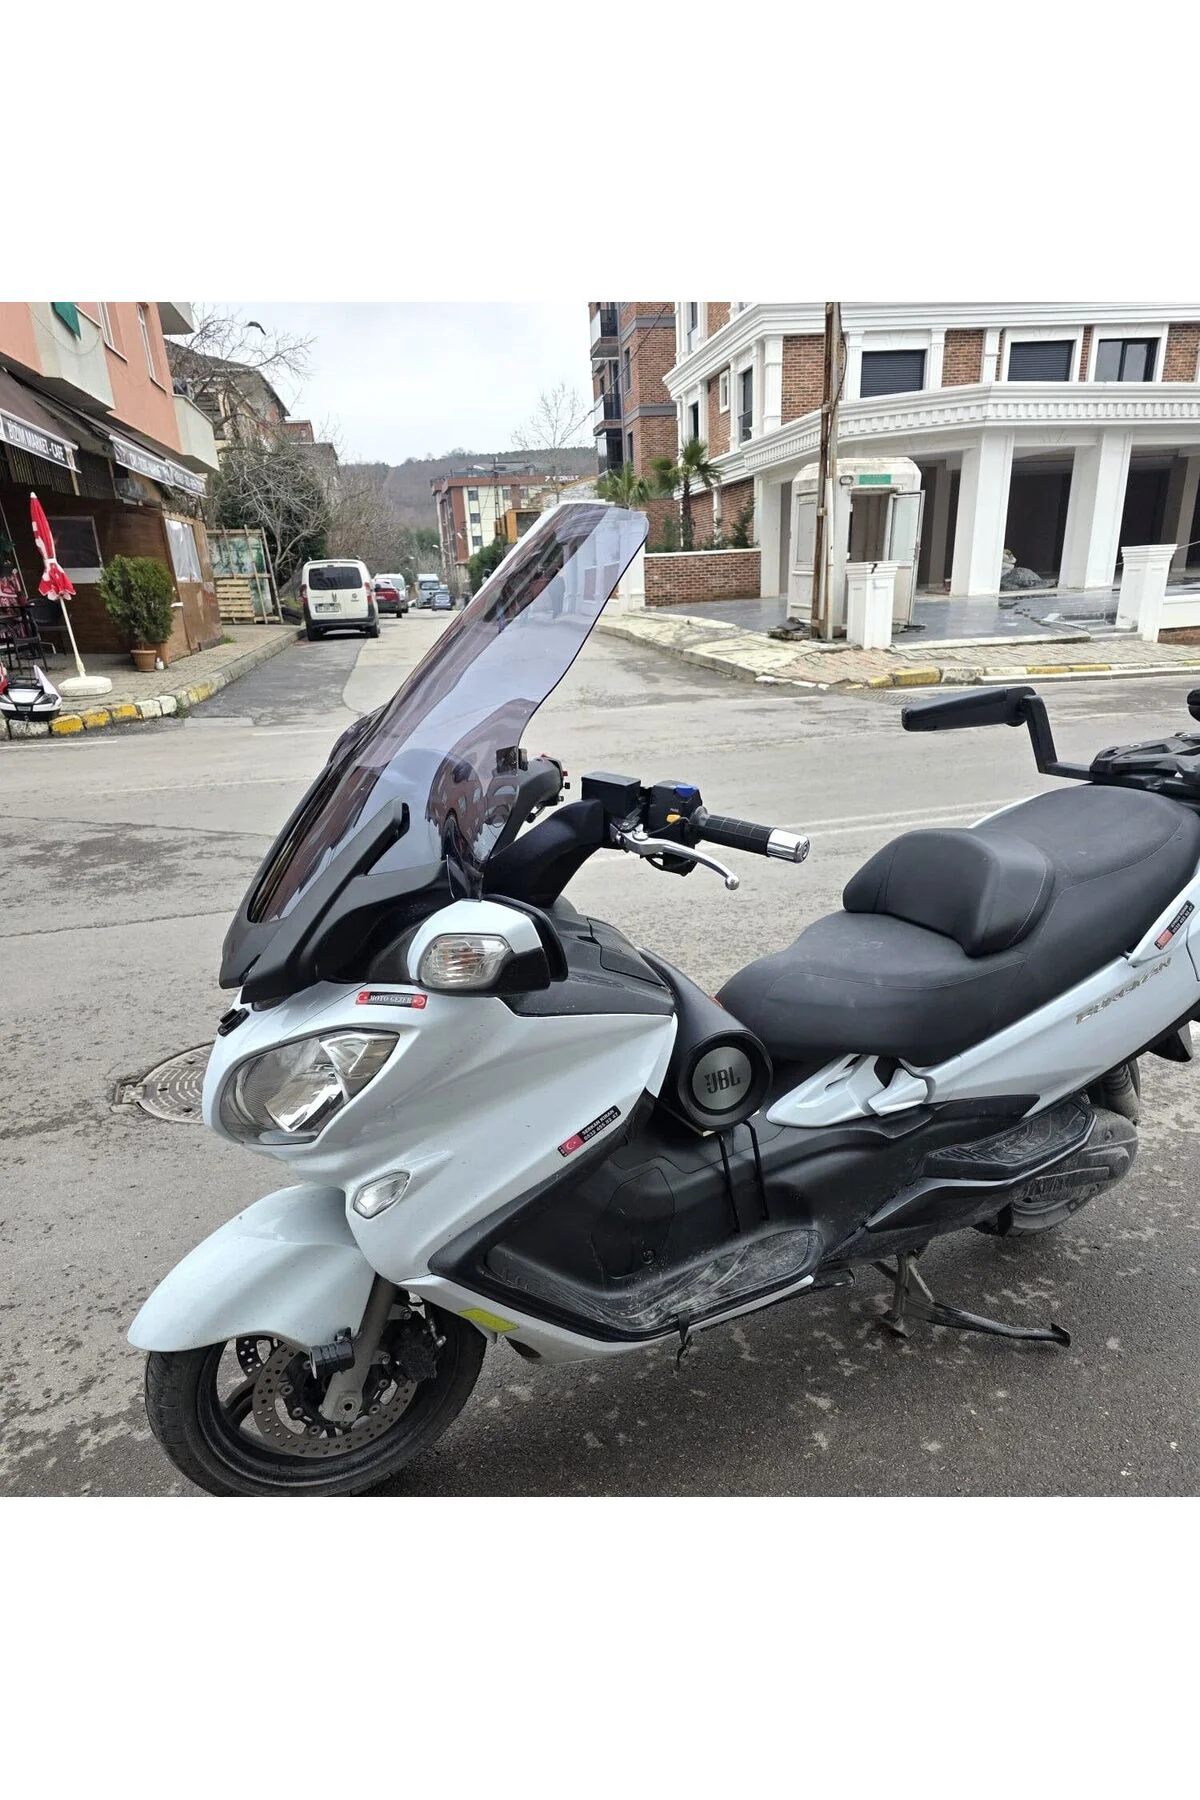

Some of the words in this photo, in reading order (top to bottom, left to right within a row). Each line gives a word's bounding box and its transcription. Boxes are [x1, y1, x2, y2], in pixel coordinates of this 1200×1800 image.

[25, 430, 50, 455] MARKET
[51, 443, 66, 462] CAFE
[369, 994, 389, 1002] MOTO
[704, 1066, 741, 1094] JBL
